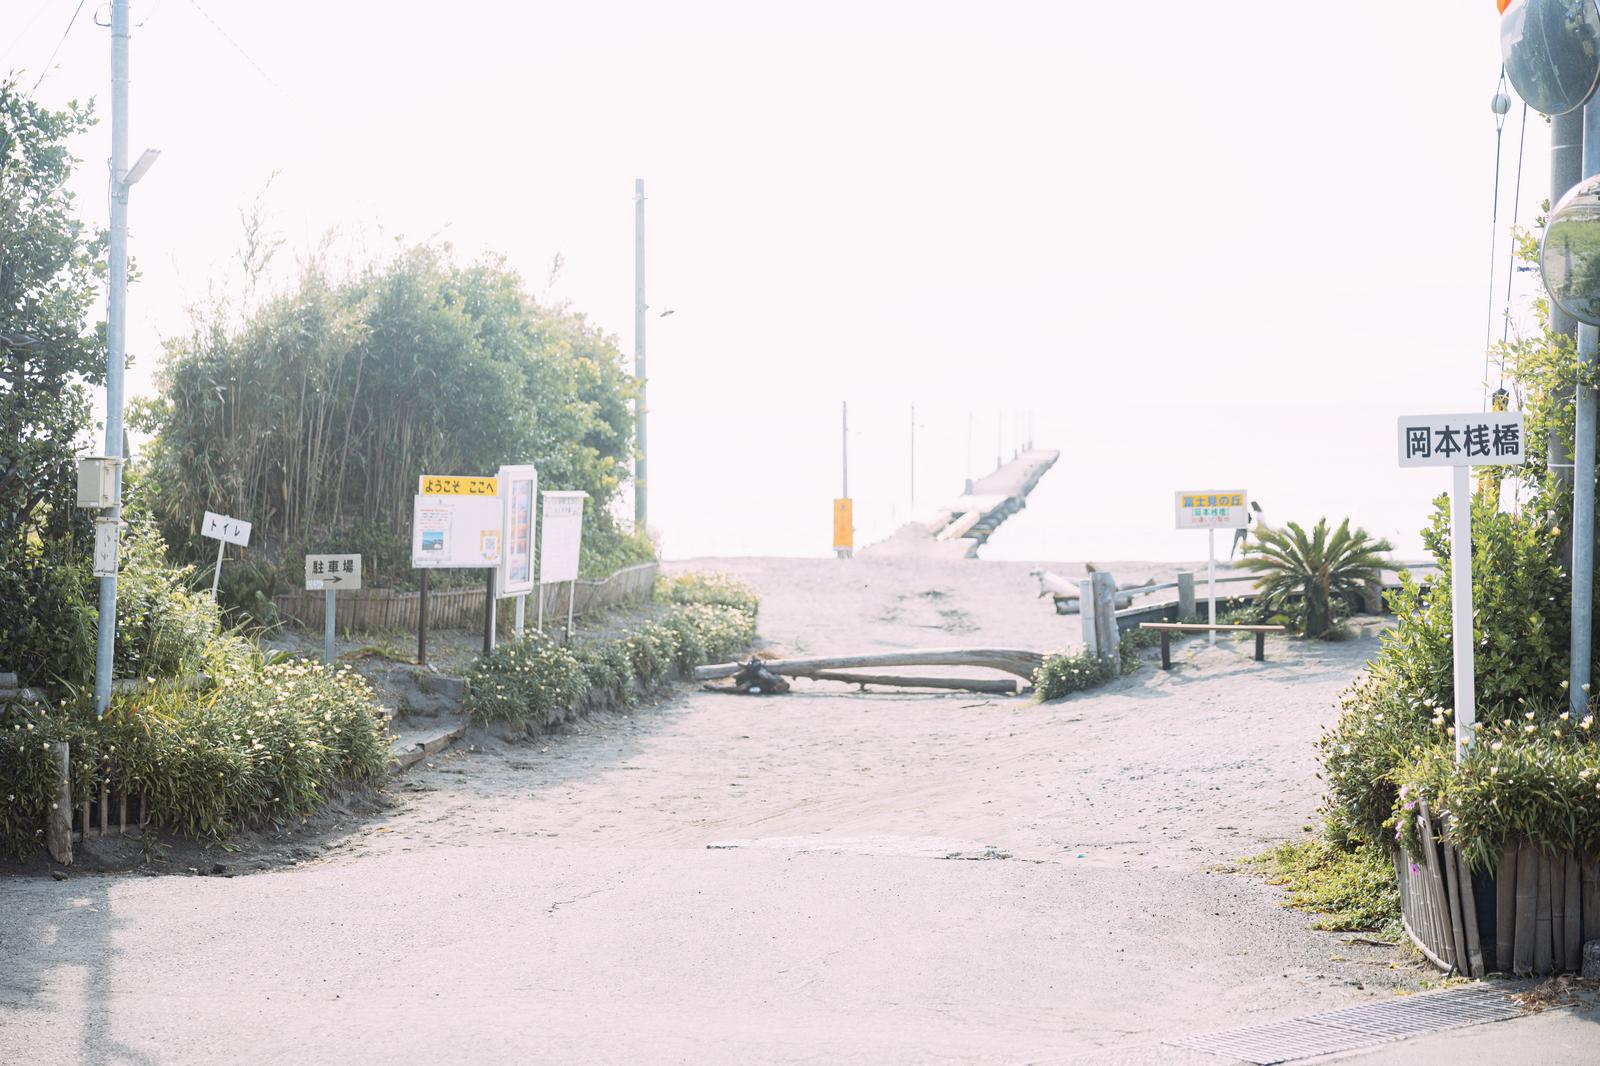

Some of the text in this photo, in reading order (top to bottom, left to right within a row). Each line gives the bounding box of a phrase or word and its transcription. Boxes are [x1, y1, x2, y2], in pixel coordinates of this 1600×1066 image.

[1406, 423, 1520, 459] 岡本桟橋
[425, 479, 494, 494] ようこそ ここへ
[1183, 495, 1241, 507] 富士見の丘
[210, 519, 241, 537] トイレ
[312, 559, 354, 575] 駐車場
